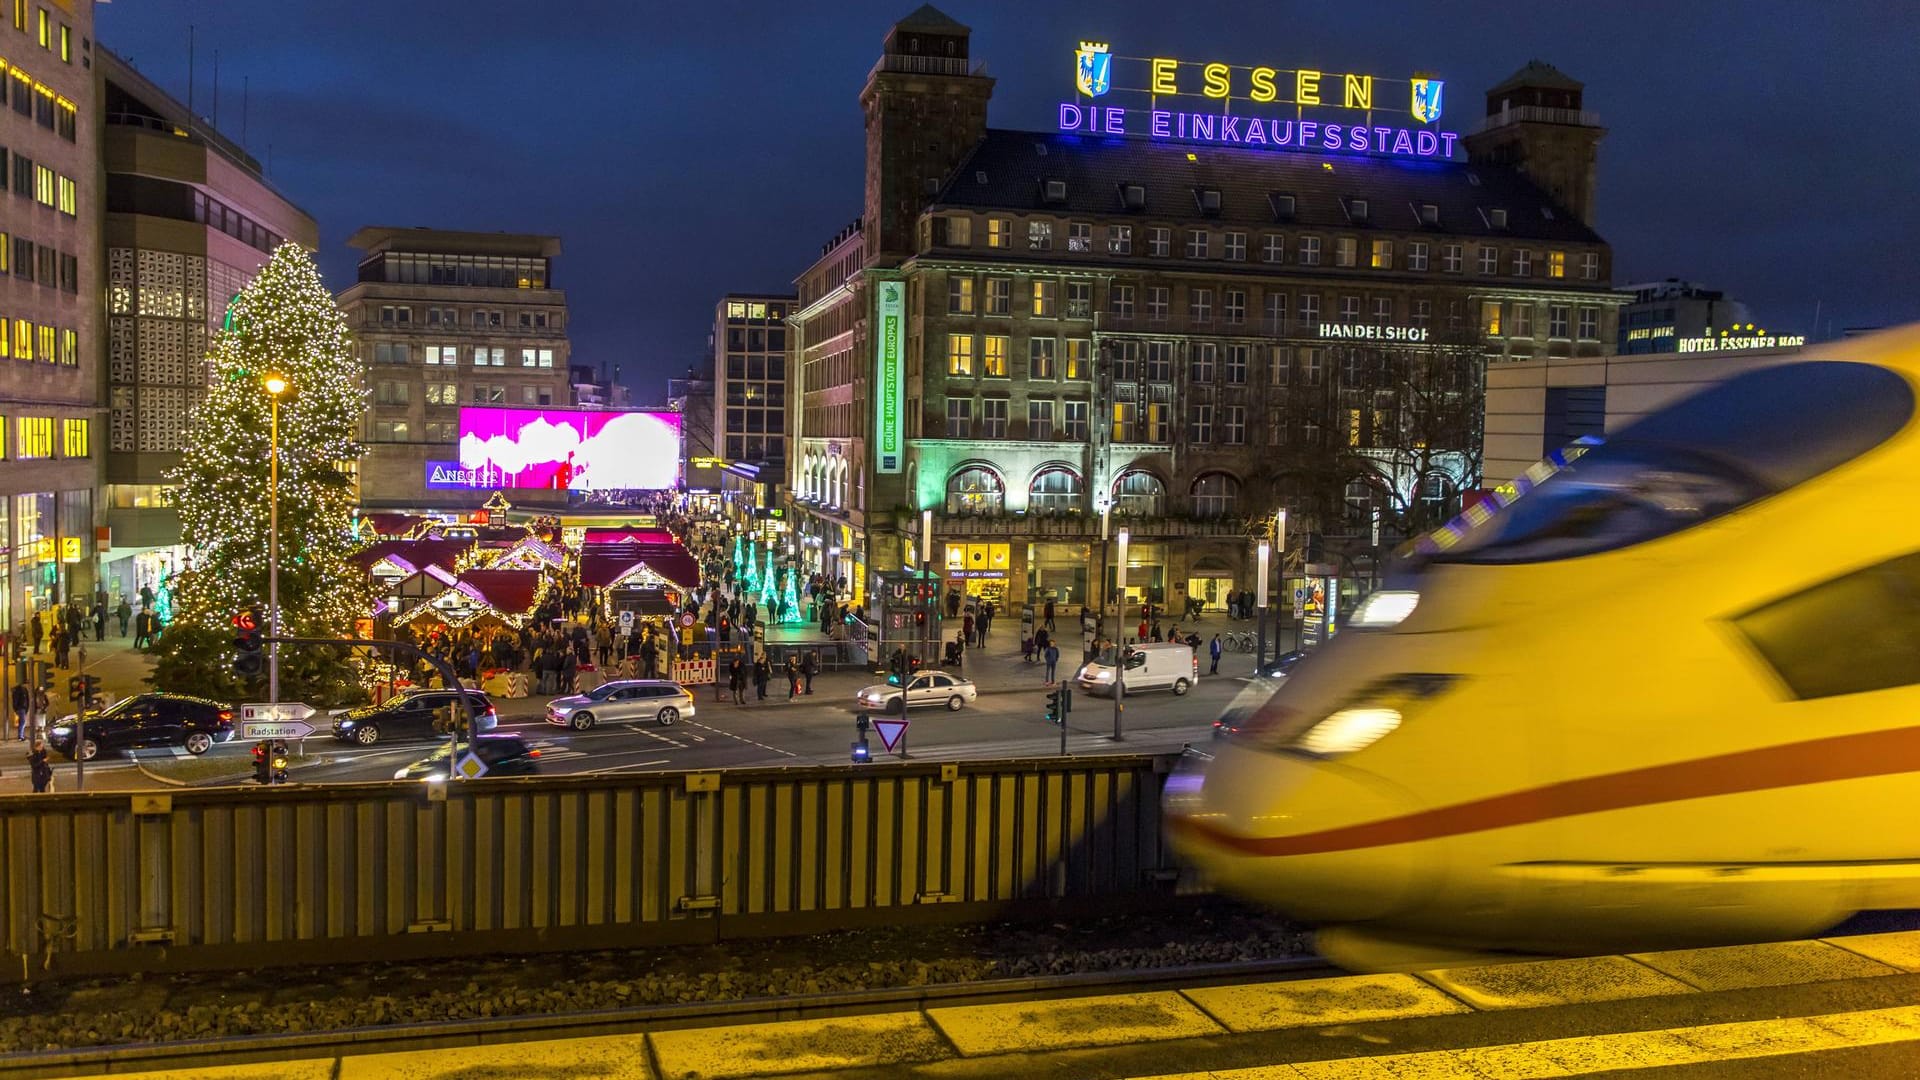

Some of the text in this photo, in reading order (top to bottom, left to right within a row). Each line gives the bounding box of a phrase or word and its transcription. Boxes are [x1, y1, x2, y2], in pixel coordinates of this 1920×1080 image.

[1152, 58, 1373, 109] ESSEN
[1060, 103, 1458, 158] DIE EINKAUFSSTADT
[886, 317, 897, 359] EUROPAS
[1319, 323, 1430, 341] HANDELSHOF
[1678, 337, 1718, 353] HOTEL
[885, 362, 896, 418] HAUPTSTADT
[885, 420, 895, 450] GRÜNE
[251, 727, 296, 736] Radstation
